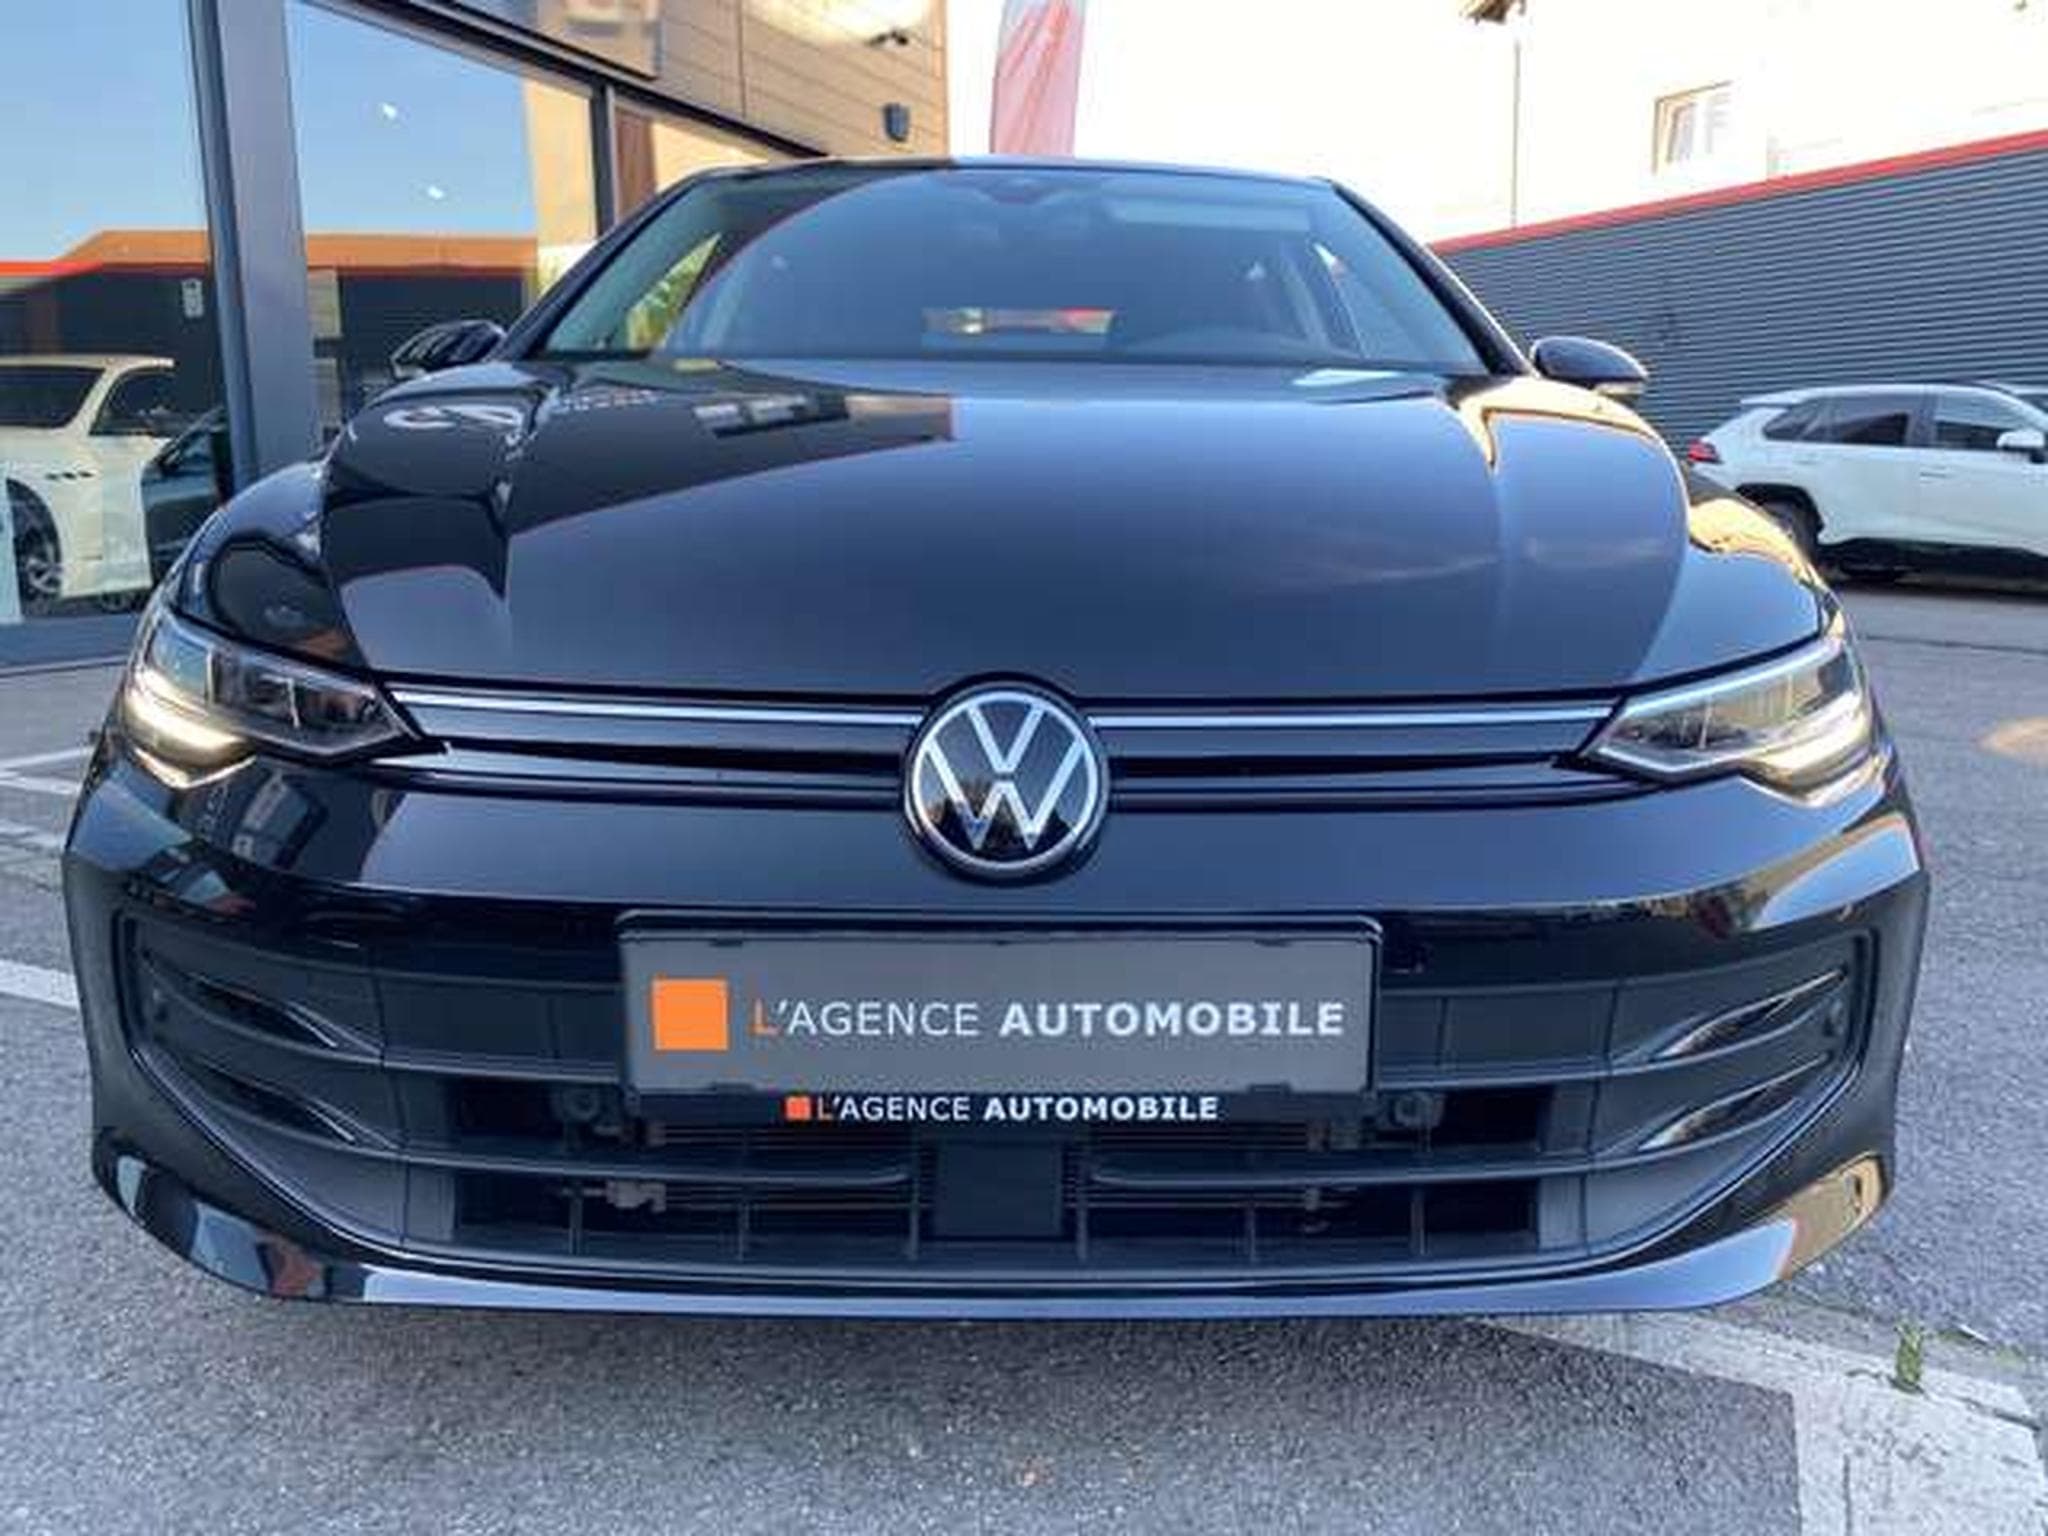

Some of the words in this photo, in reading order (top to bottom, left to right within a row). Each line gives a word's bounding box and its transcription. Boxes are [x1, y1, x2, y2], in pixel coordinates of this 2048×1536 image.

[920, 698, 1090, 856] VW
[752, 1000, 980, 1036] L'AGENCE
[999, 1001, 1345, 1037] AUTOMOBILE
[817, 1096, 971, 1121] L'AGENCE
[983, 1096, 1218, 1121] AUTOMOBILE
